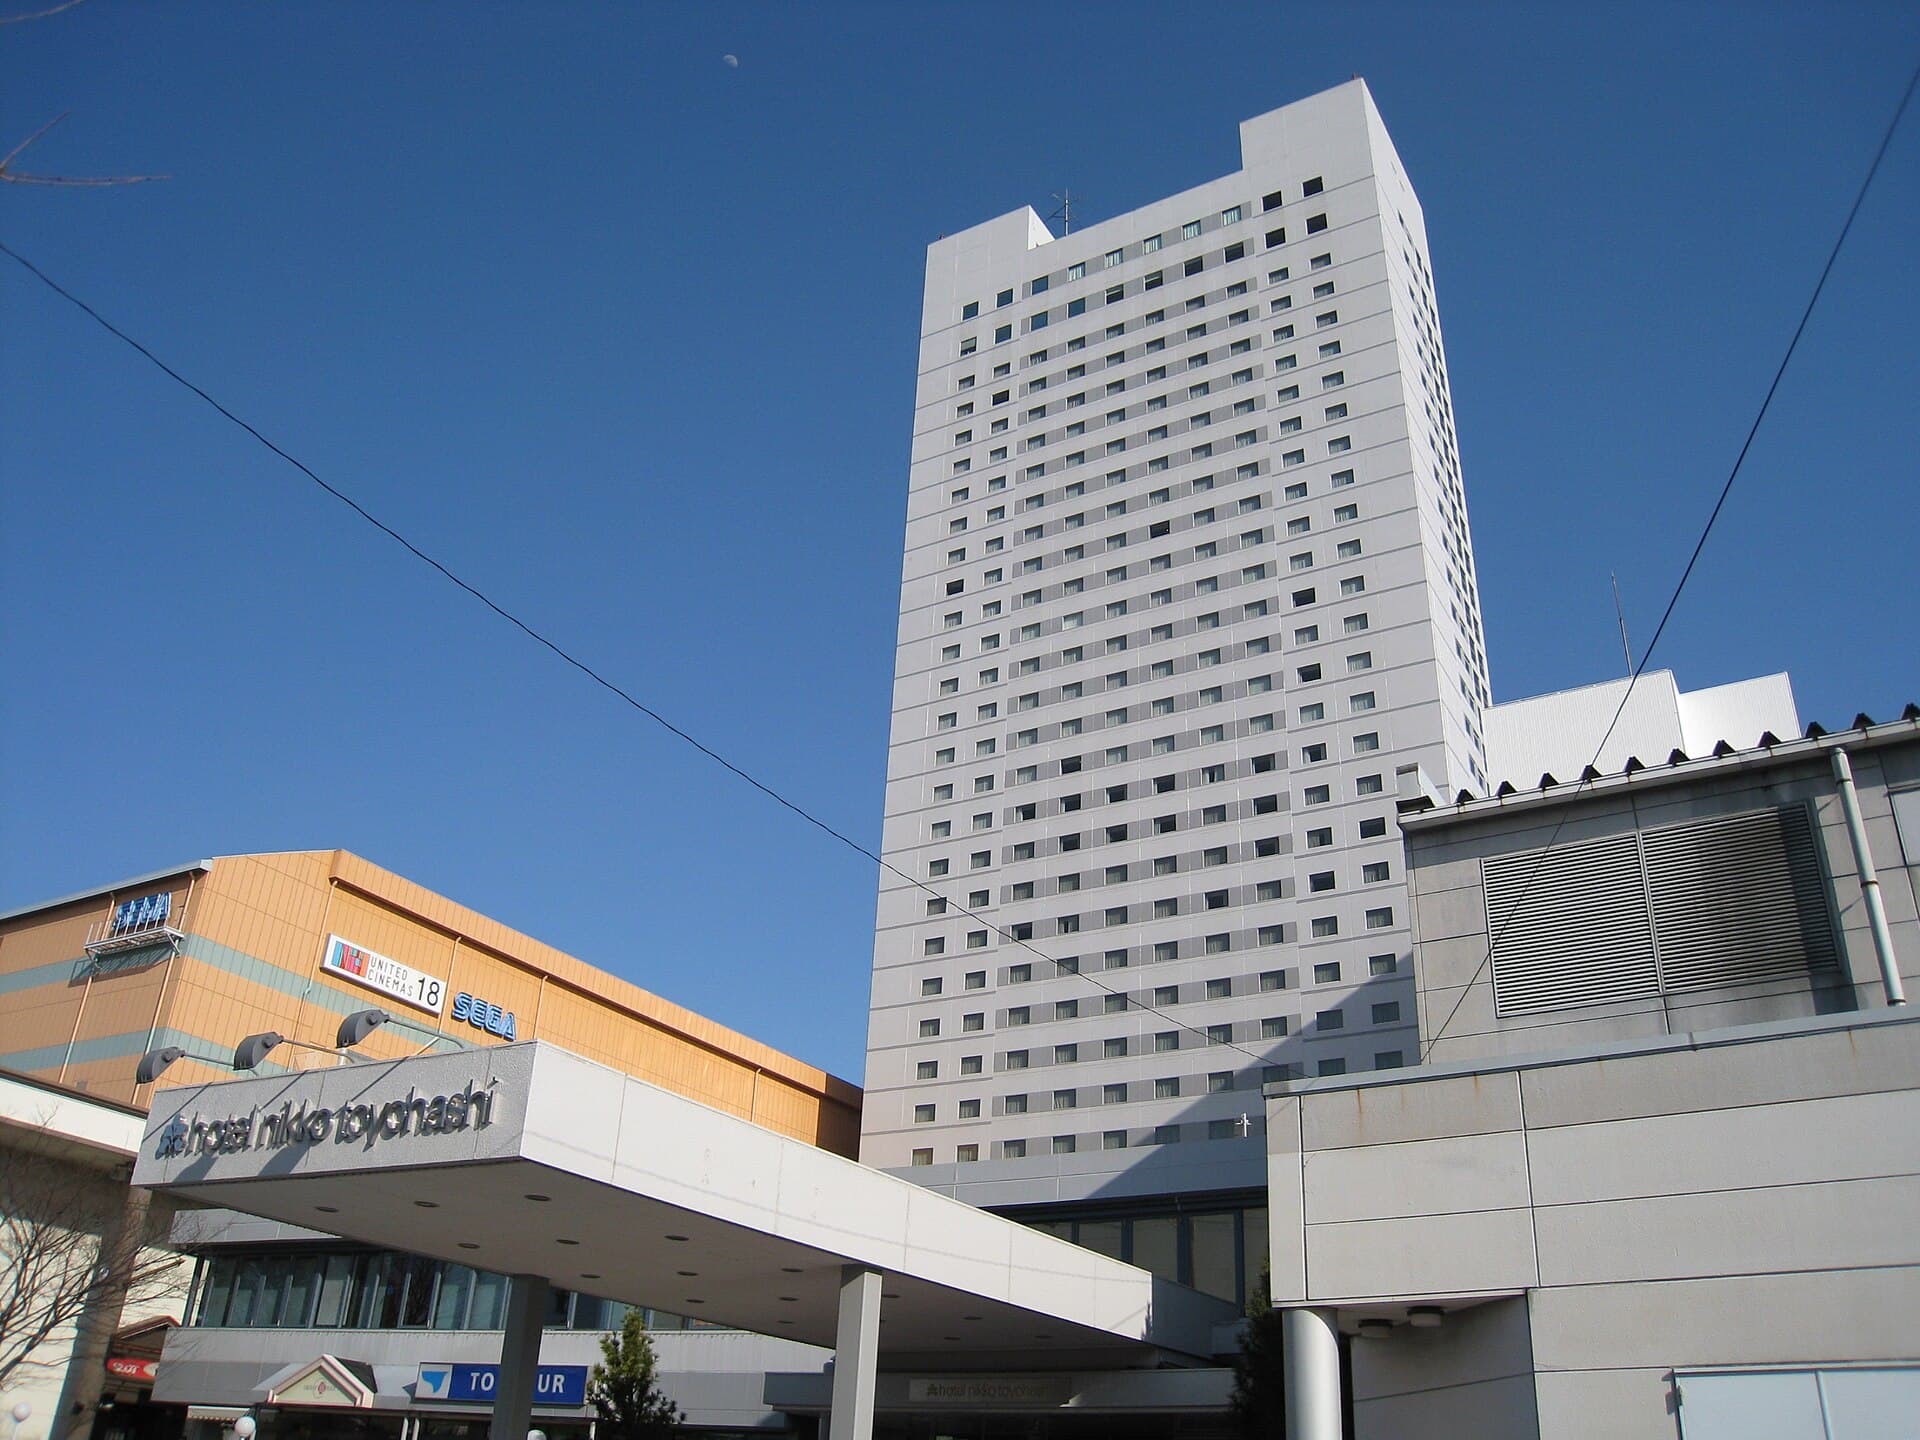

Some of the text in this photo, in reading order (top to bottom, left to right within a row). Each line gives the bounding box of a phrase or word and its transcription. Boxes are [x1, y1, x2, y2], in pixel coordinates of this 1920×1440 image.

[367, 969, 414, 997] CINEMAS
[371, 955, 408, 981] UNITED
[417, 976, 440, 1006] 18
[452, 991, 516, 1041] SEGA
[185, 1076, 500, 1157] hotel nikko toyohashi
